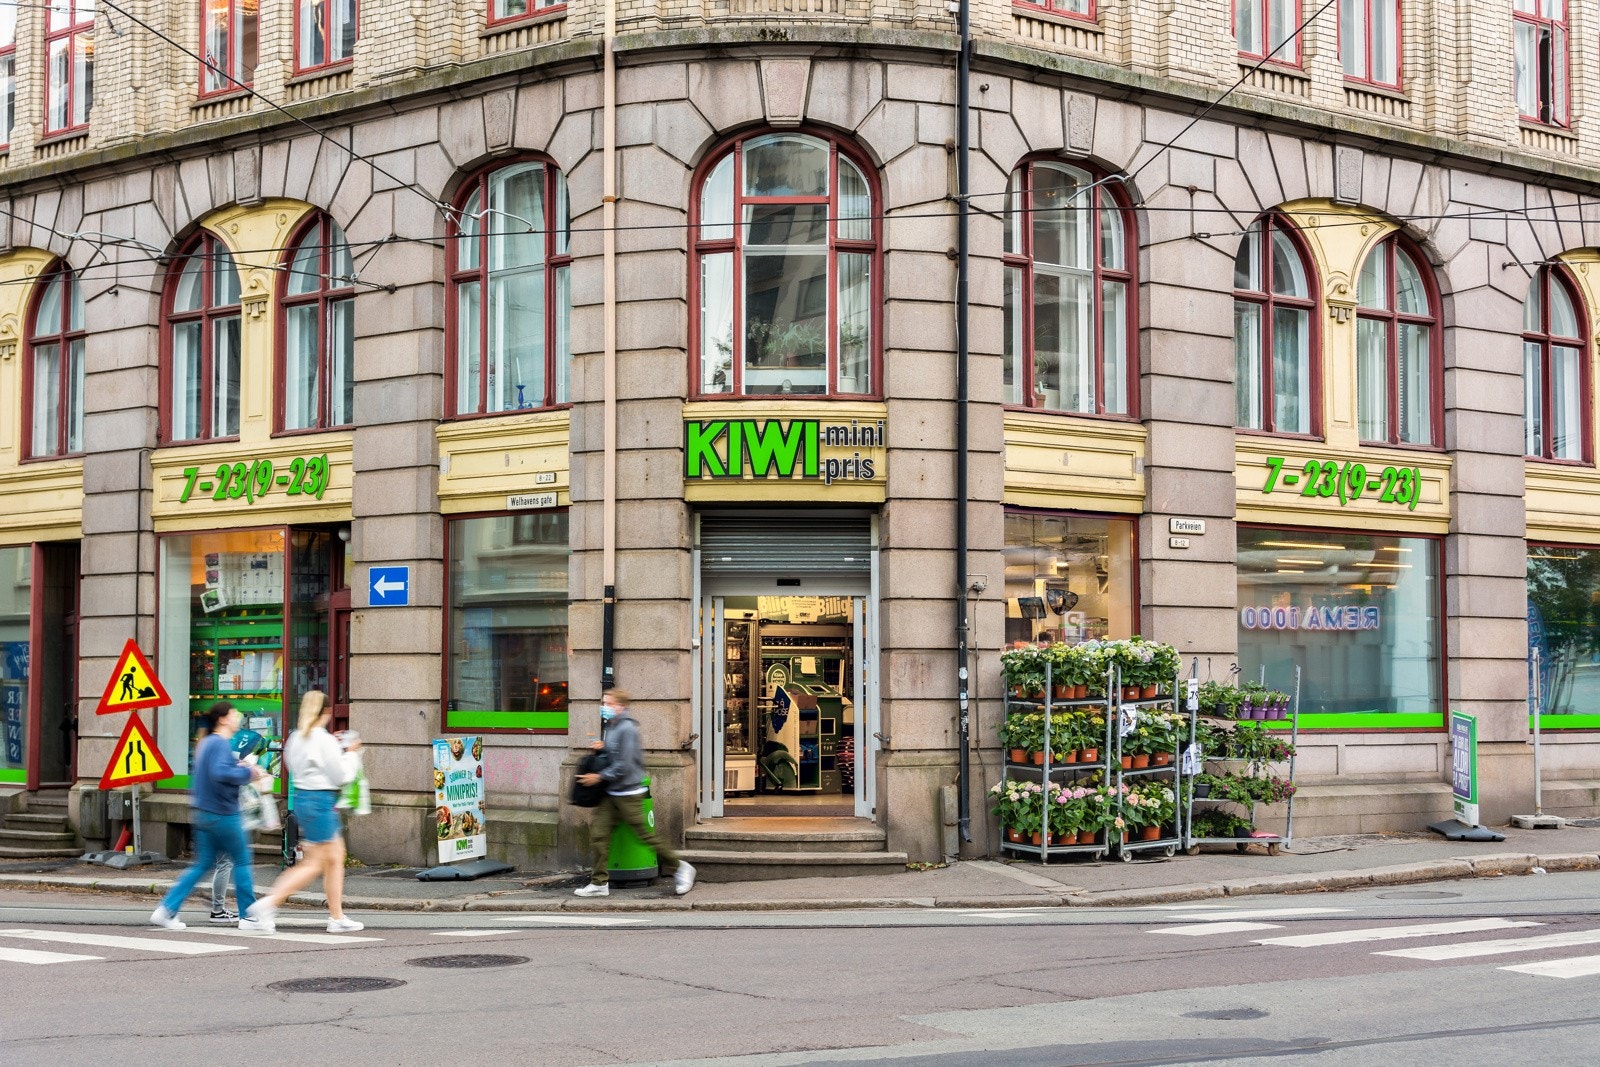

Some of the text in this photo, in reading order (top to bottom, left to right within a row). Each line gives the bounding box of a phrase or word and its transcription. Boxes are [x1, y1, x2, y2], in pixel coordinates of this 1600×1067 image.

[686, 419, 884, 479] KIWI mini
[825, 452, 875, 485] pris
[511, 495, 553, 507] Welhavens gate
[1176, 520, 1202, 530] Parkveien
[819, 597, 848, 616] Billig
[446, 782, 478, 801] MINIPRIS!
